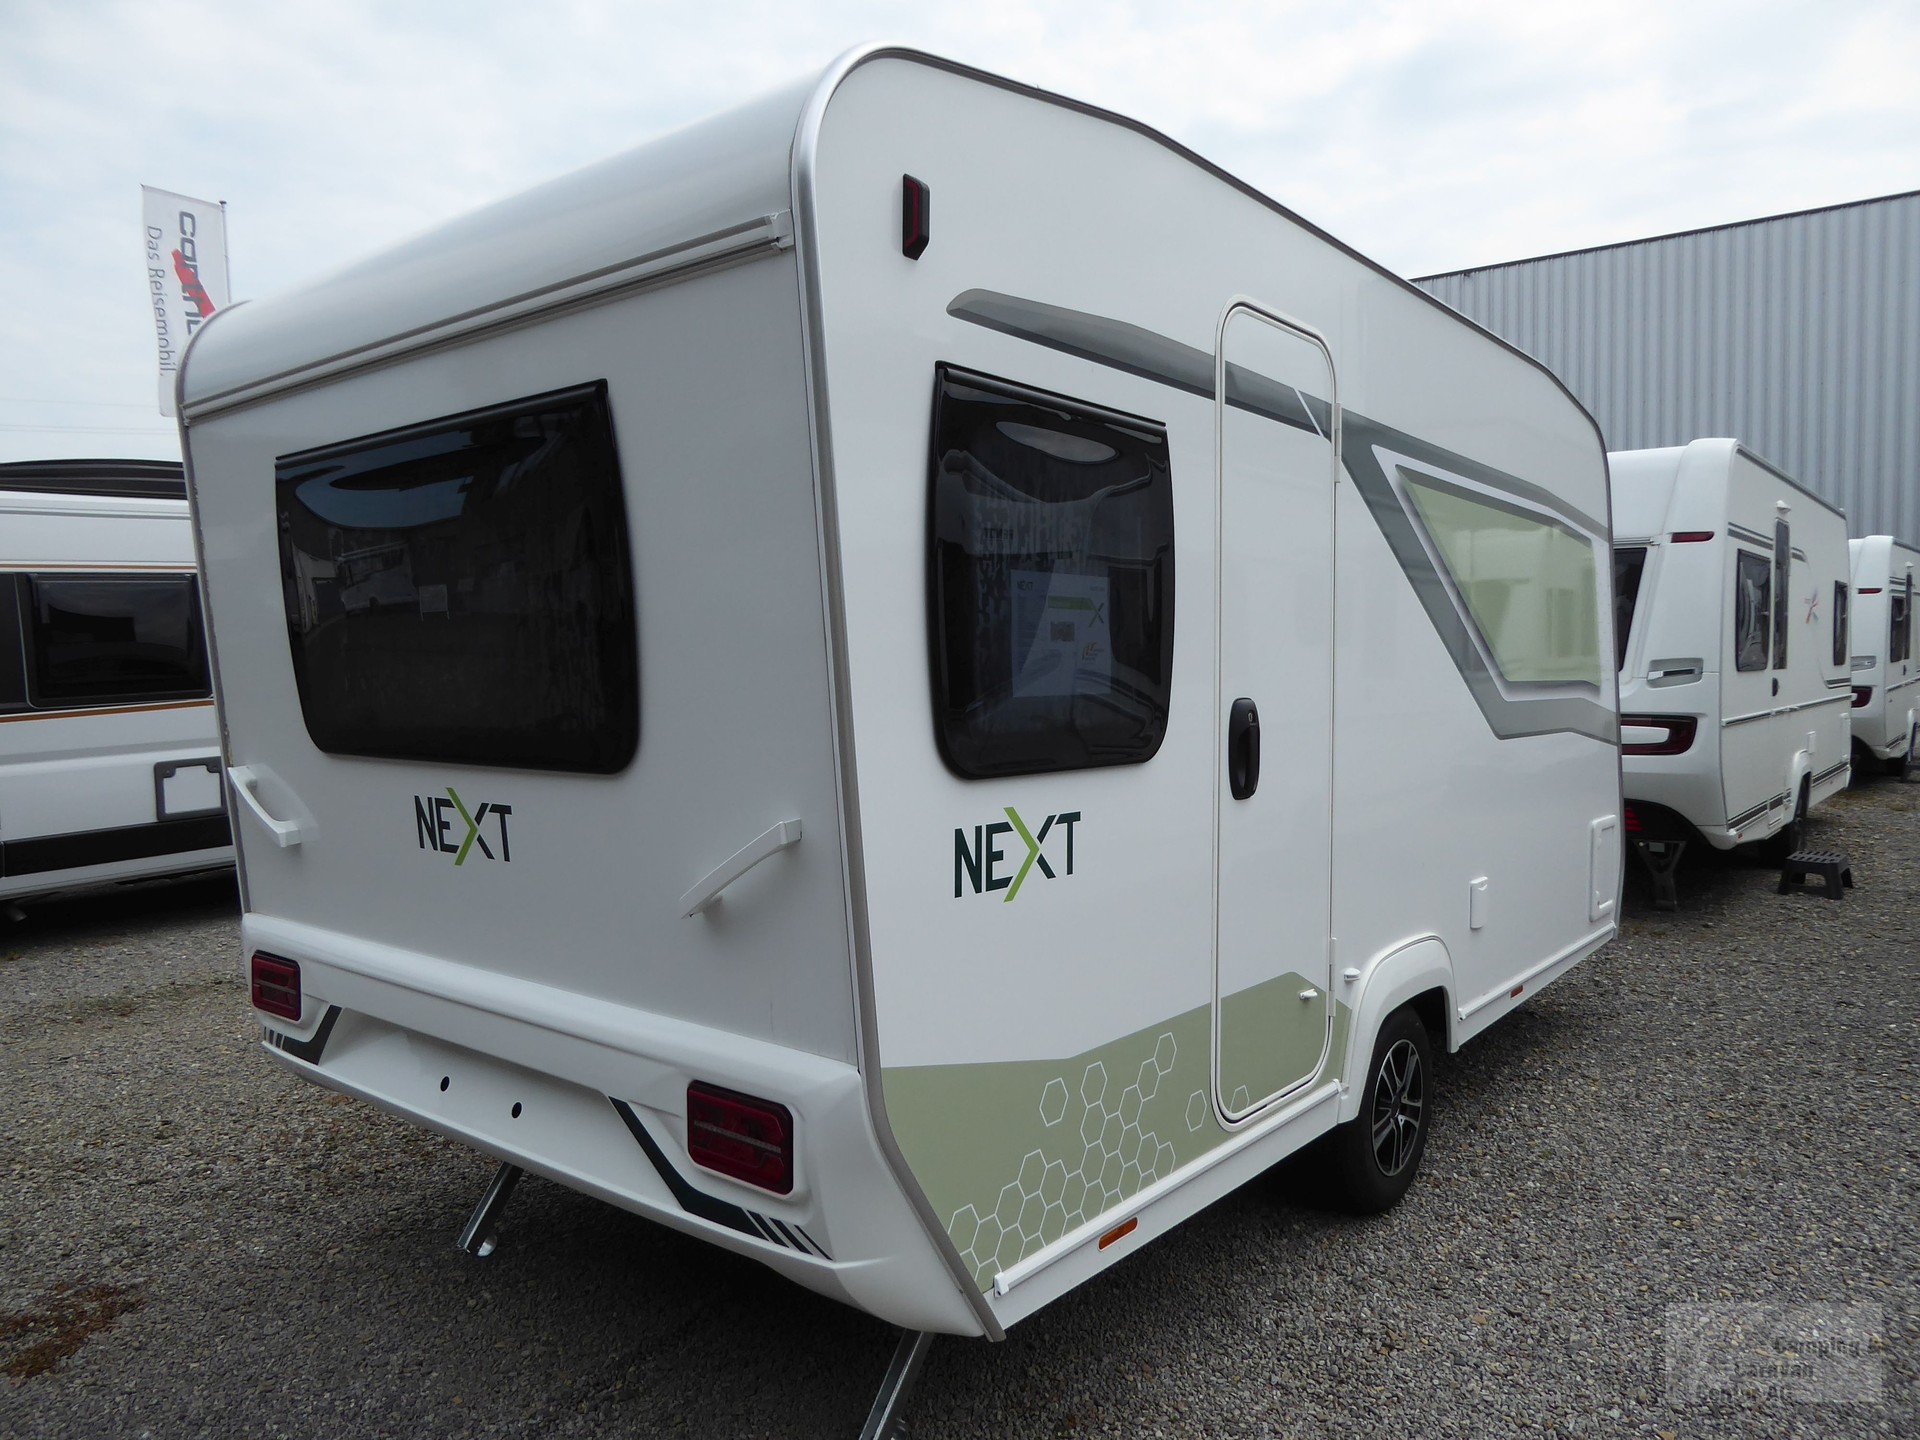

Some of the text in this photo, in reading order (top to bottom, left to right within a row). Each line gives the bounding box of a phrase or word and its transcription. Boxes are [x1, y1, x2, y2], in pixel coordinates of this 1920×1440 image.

[147, 225, 162, 260] Das
[414, 787, 512, 866] NEXT
[954, 806, 1081, 903] NEXT
